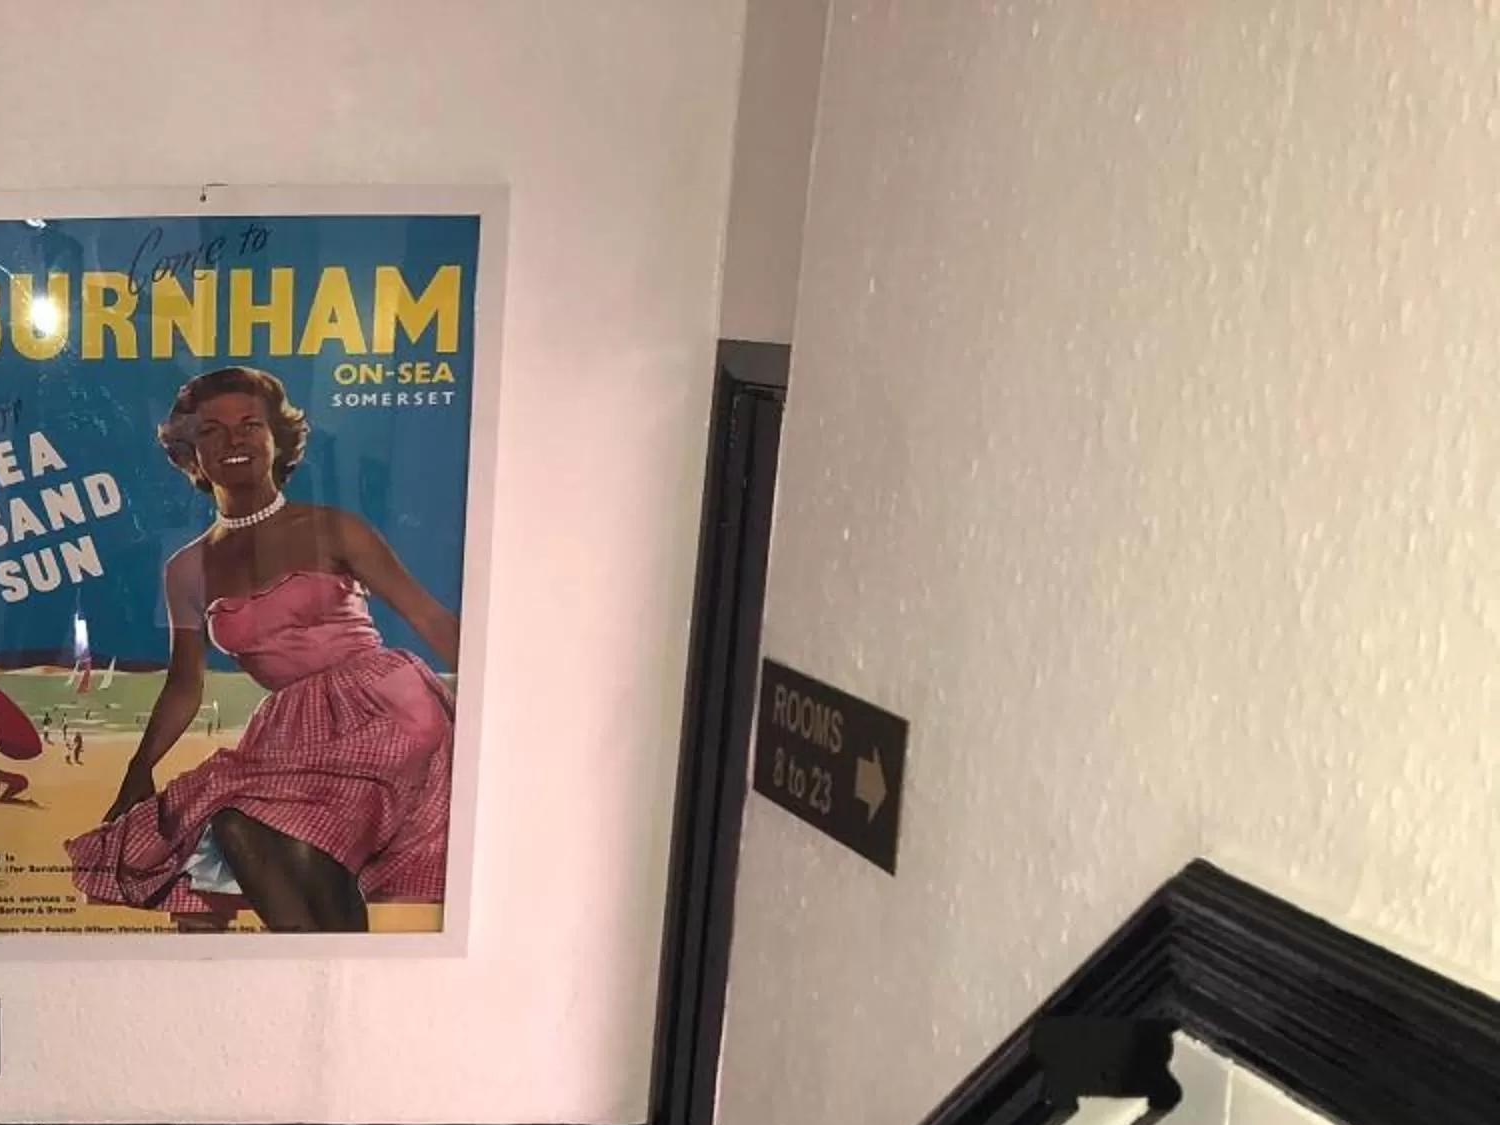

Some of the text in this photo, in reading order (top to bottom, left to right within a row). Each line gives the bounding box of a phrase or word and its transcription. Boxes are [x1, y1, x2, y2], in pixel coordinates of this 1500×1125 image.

[128, 222, 277, 297] Come to
[331, 391, 456, 408] SOMERSET
[333, 361, 456, 385] ON-SEA
[772, 683, 845, 754] ROOMS
[772, 747, 833, 816] 8 to 23
